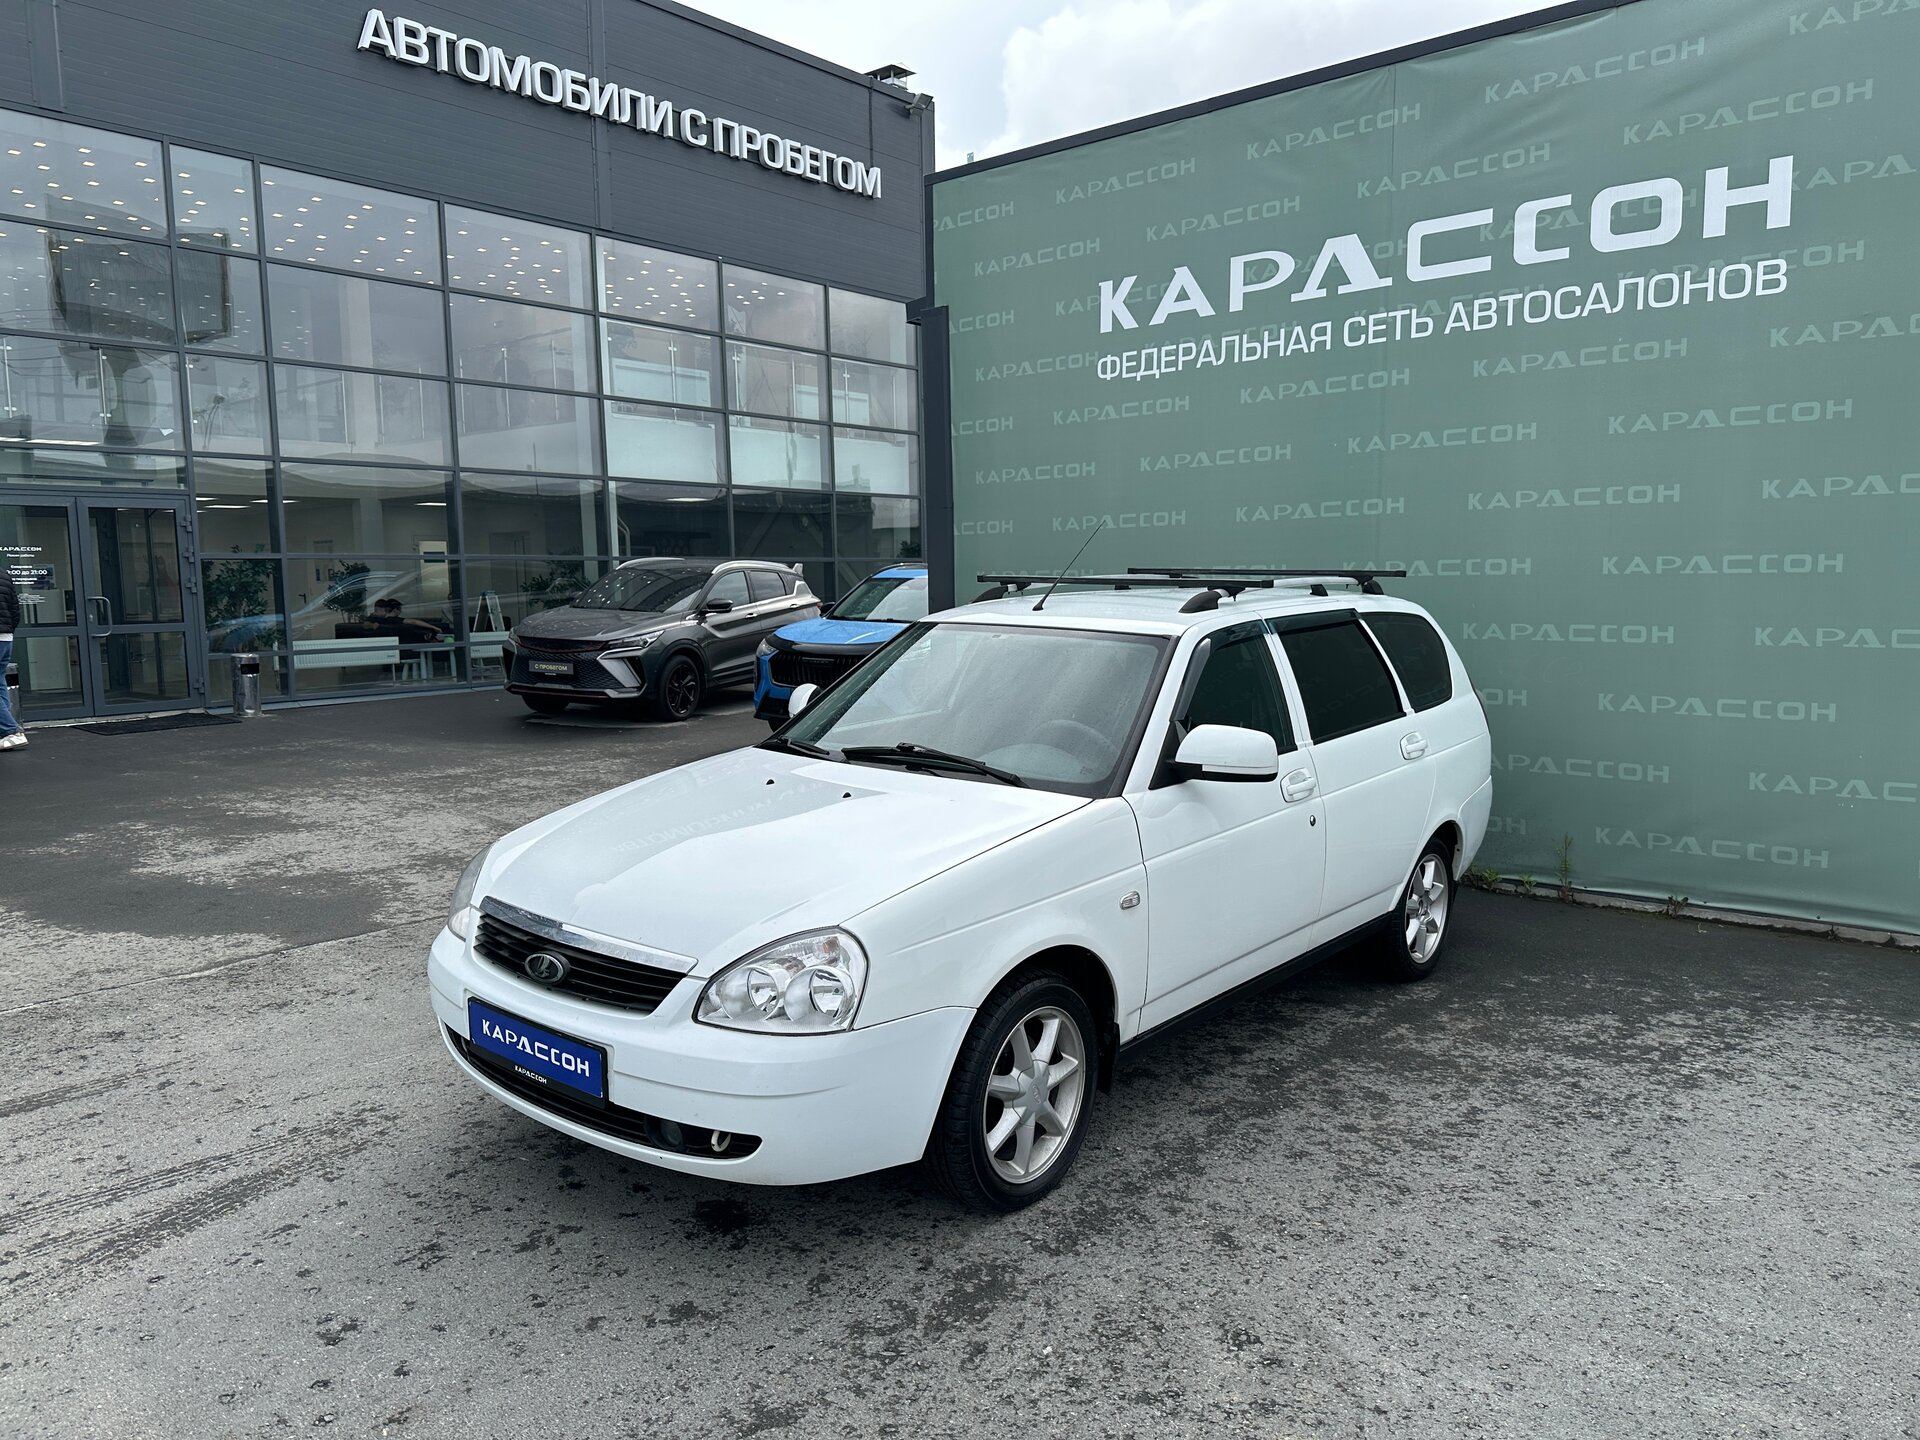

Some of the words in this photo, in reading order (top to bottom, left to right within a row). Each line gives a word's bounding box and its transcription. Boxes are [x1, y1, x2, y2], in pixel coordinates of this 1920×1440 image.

[1484, 37, 1705, 104] КАРАССОН
[357, 8, 673, 138] АВТОМОБИЛИ
[680, 108, 708, 147] С
[713, 117, 882, 199] ПРОБЕГОМ
[1623, 78, 1874, 146] КАРАССОН
[1246, 102, 1421, 161] КАРАССОН
[1056, 157, 1197, 205] КАРАССОН
[1357, 142, 1551, 199] КАРАССОН
[1146, 195, 1300, 242] КАРАССОН
[974, 237, 1100, 277] КАРАССОН
[1098, 154, 1794, 334] КАРАССОН
[1097, 320, 1332, 381] ФЕДЕРАЛЬНАЯ
[1343, 308, 1434, 347] СЕТЬ
[1444, 258, 1789, 335] АВТОСАЛОНОВ
[1473, 338, 1688, 377] КАРАССОН
[1240, 367, 1410, 404] КАРАССОН
[1053, 395, 1190, 426] КАРАССОН
[1608, 398, 1853, 434] КАРАССОН
[1347, 421, 1538, 454] КАРАССОН
[975, 462, 1096, 484] КАРАССОН
[1140, 443, 1292, 472] КАРАССОН
[1236, 497, 1405, 523] КАРАССОН
[1467, 483, 1681, 511] КАРАССОН
[1053, 509, 1187, 532] КАРАССОН
[1602, 553, 1844, 575] КАРАССОН
[1462, 622, 1675, 645] КАРАССОН
[1597, 692, 1837, 723] КАРАССОН
[1595, 827, 1830, 869] КАРАССОН
[481, 1018, 590, 1077] КАРАССОН
